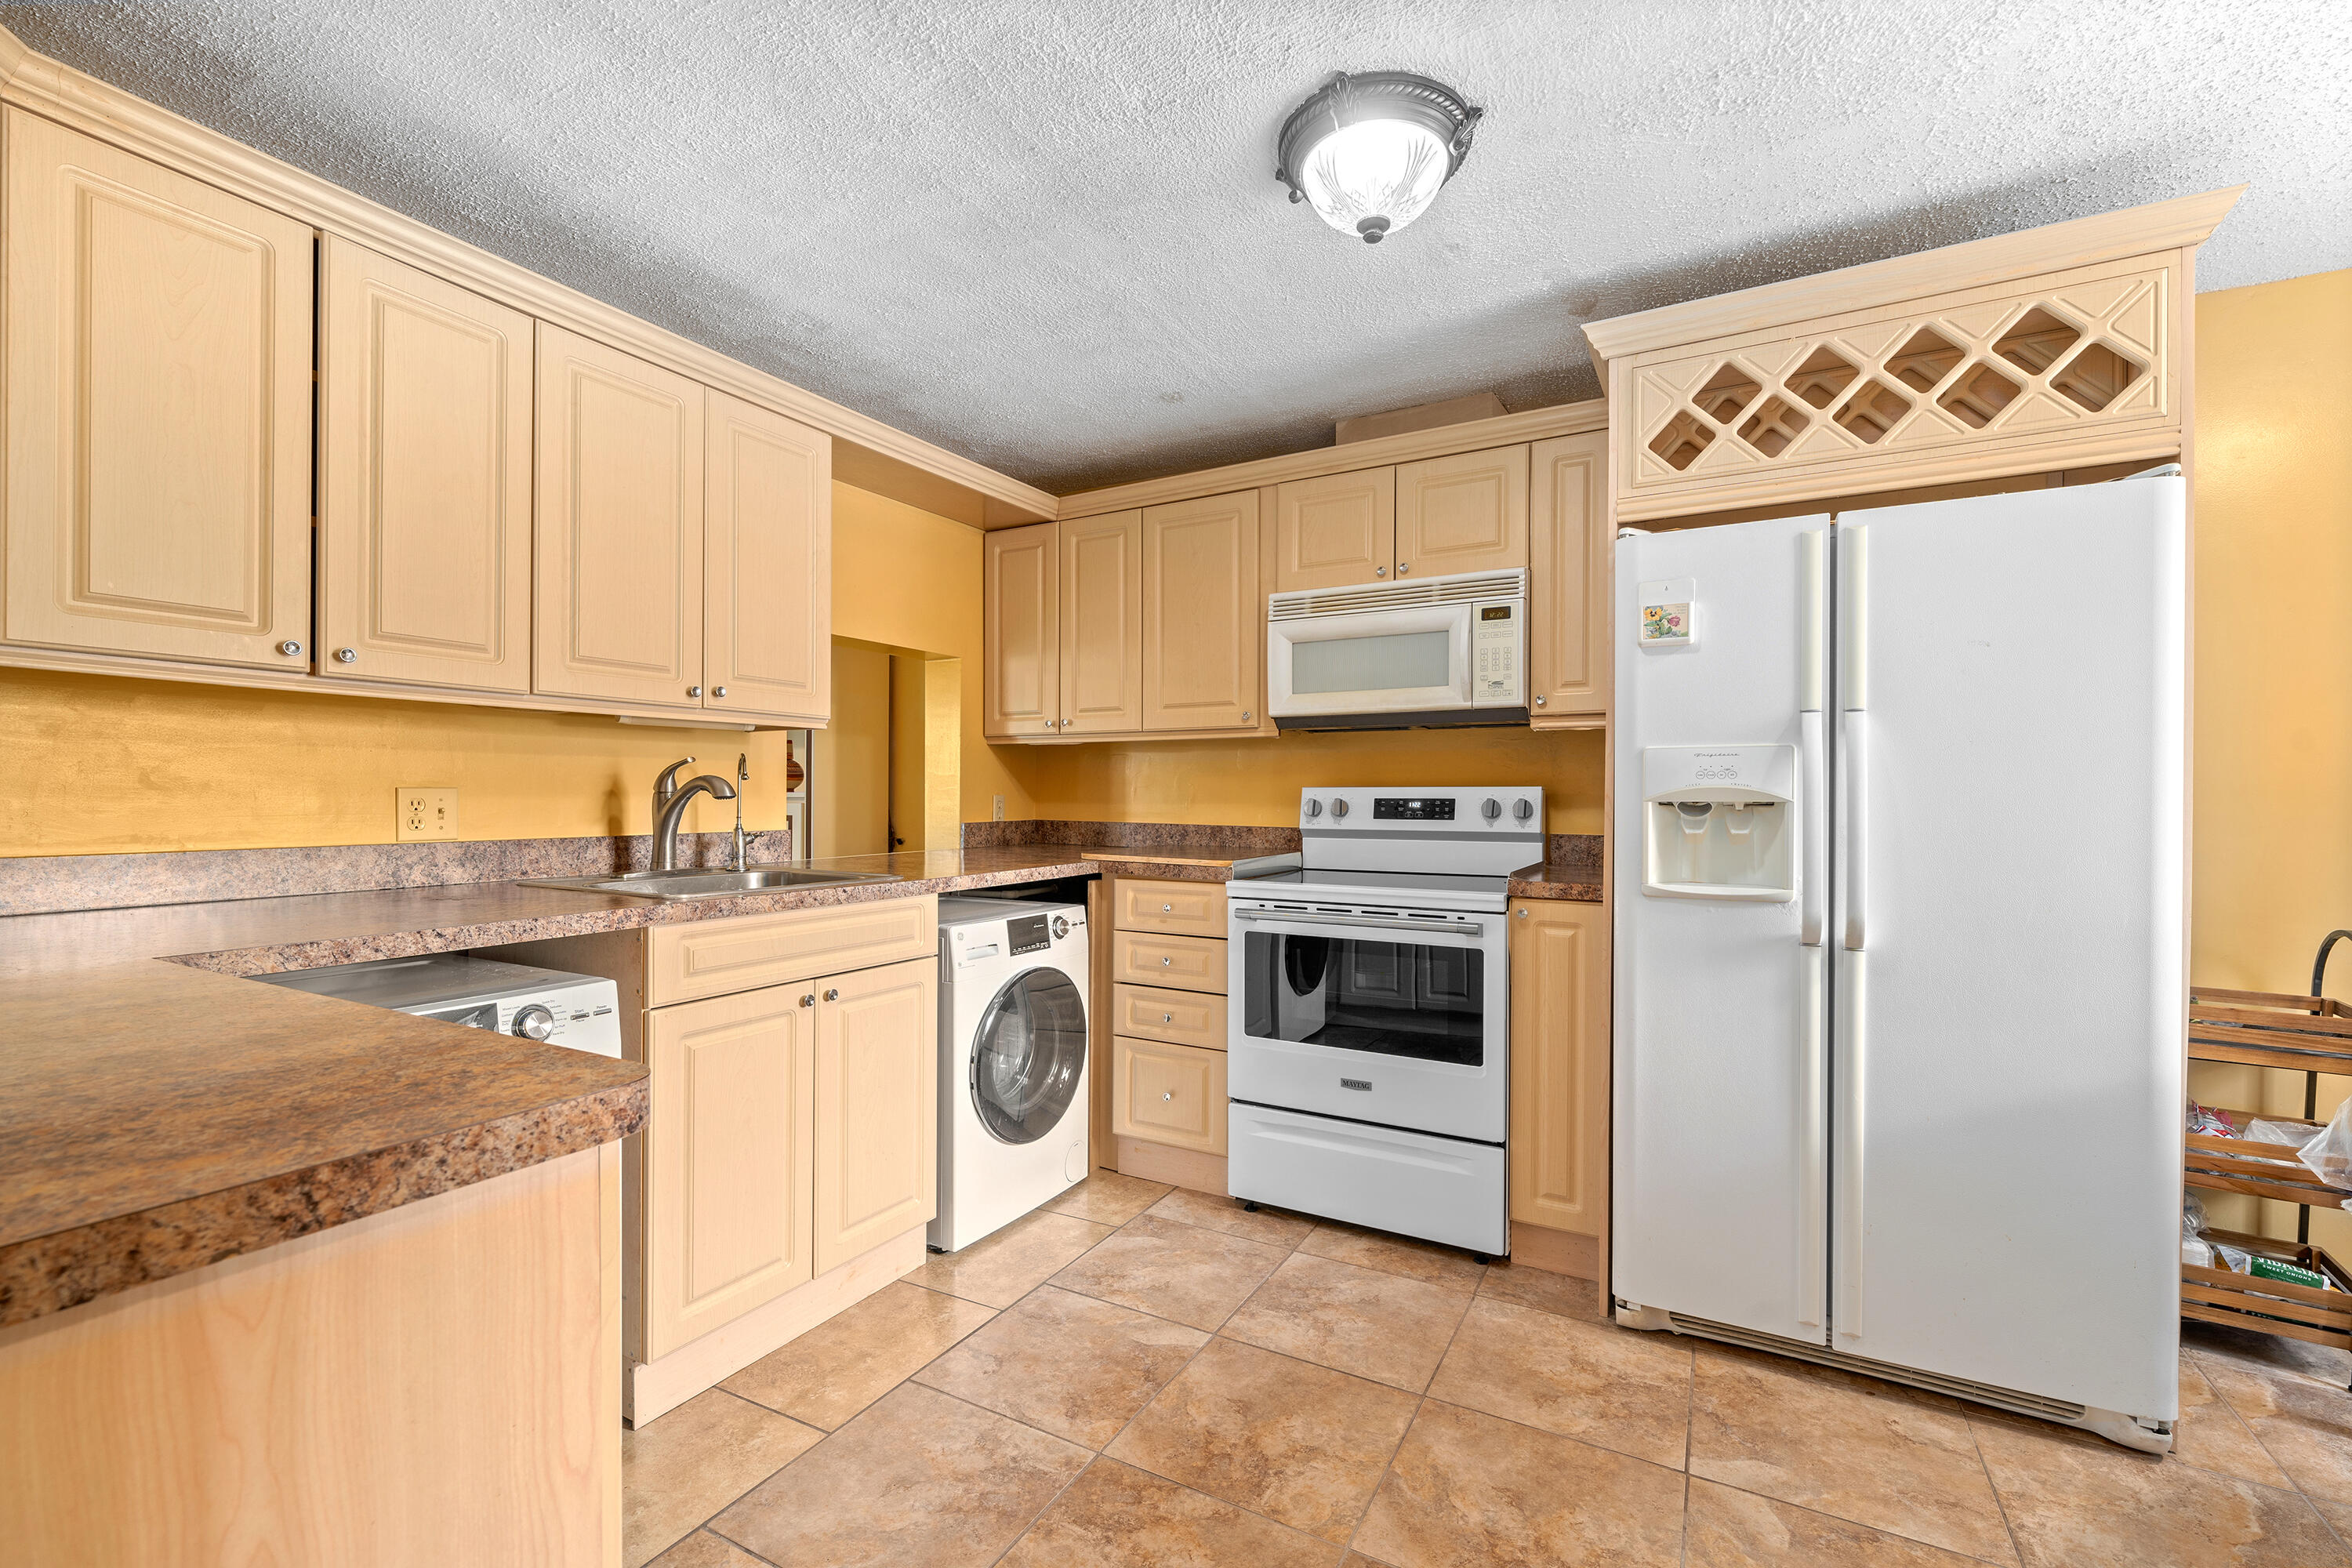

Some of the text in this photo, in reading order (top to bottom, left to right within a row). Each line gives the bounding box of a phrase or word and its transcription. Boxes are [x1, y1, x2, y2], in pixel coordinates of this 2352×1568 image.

[1342, 1080, 1370, 1089] MAYTAG
[2256, 1257, 2319, 1279] VIDALIA
[2263, 1264, 2285, 1273] SWEET
[2286, 1271, 2312, 1281] ONIONS
